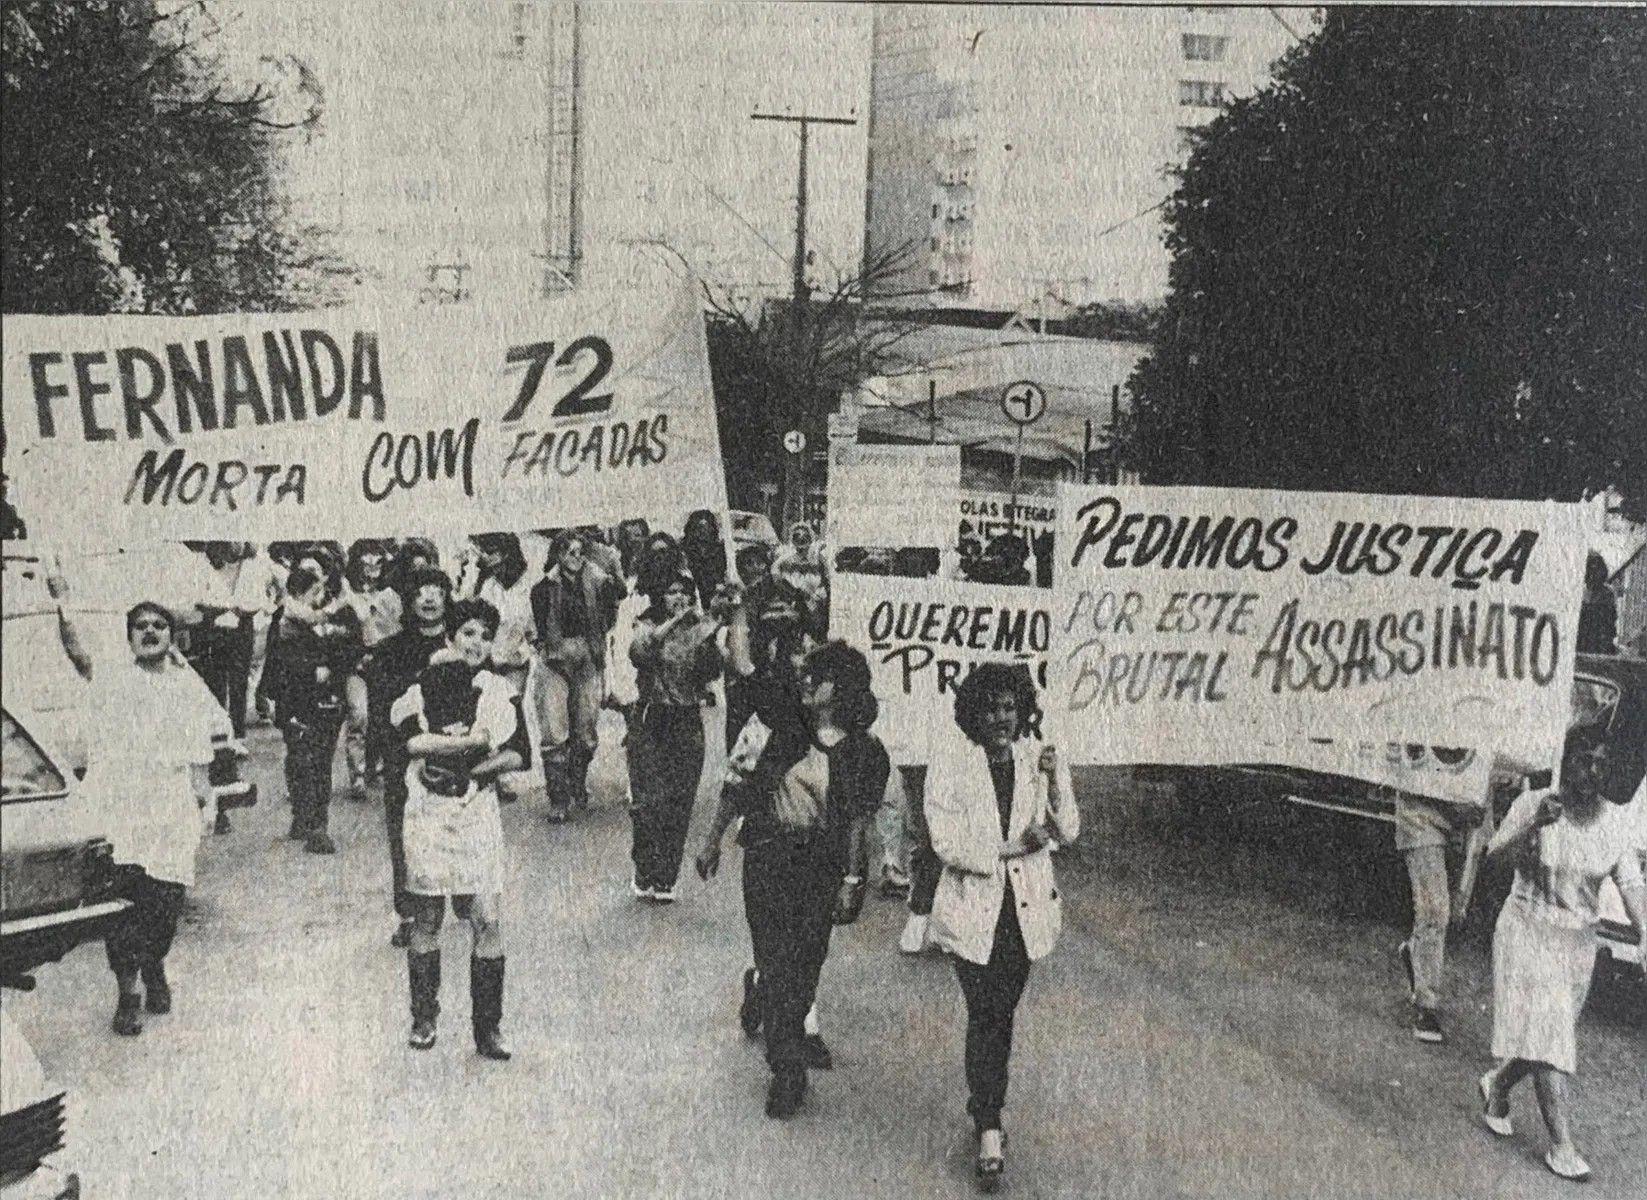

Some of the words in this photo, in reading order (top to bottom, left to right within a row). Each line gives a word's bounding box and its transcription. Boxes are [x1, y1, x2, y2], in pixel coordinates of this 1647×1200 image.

[29, 329, 386, 445] FERNANDA
[502, 336, 614, 425] 72
[124, 449, 306, 511] MORTA
[362, 418, 480, 502] COM
[502, 414, 668, 478] FACADAS
[1071, 496, 1299, 573] PEDIMOS
[1063, 590, 1143, 634] POR
[1155, 591, 1260, 636] ESTE
[1066, 638, 1229, 711] BRUTAL
[1251, 599, 1560, 694] ASSASSINATO
